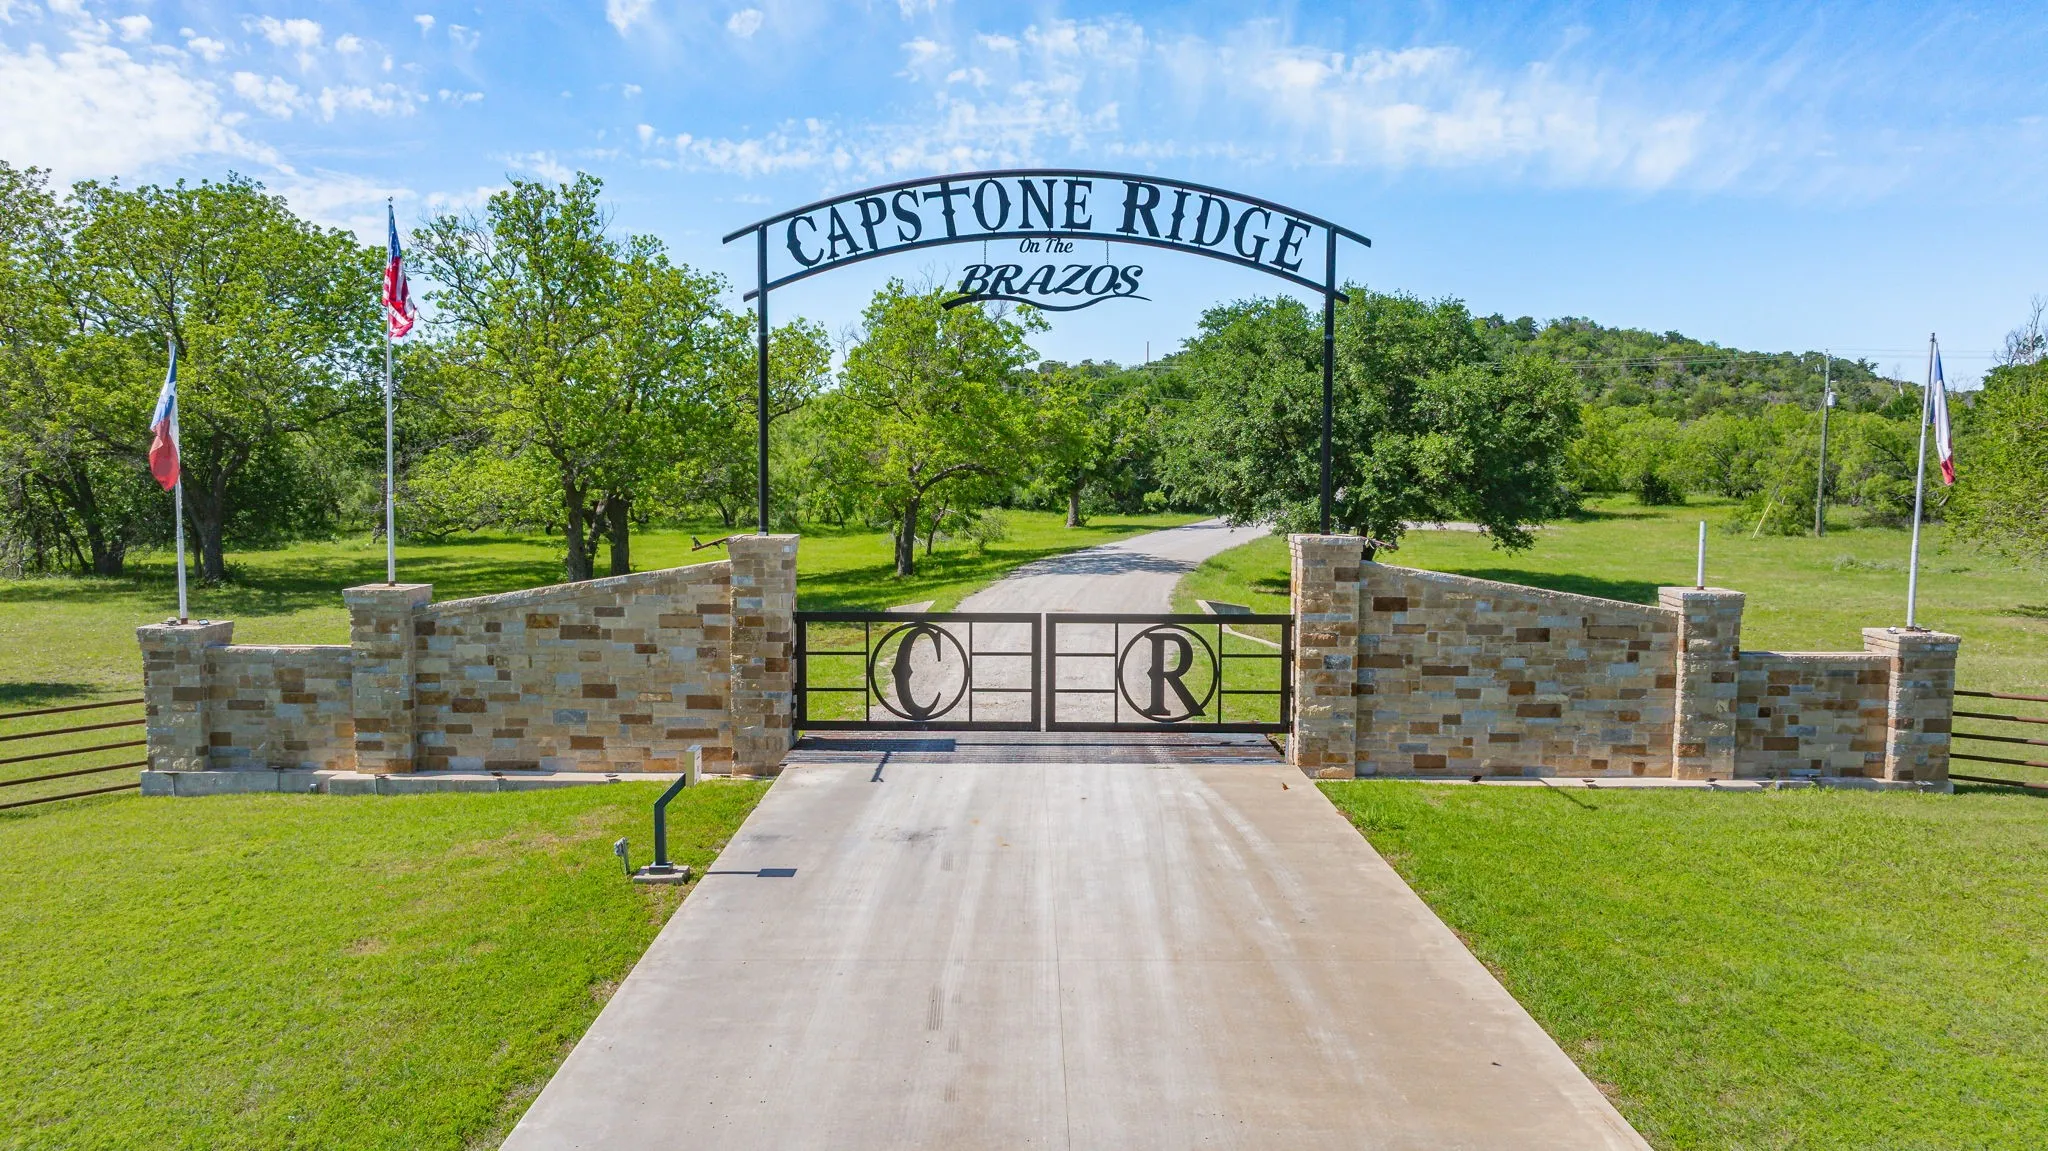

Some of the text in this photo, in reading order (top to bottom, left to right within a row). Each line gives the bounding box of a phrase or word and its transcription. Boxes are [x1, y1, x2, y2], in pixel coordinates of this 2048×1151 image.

[787, 179, 1312, 272] CAPSTONE RIDGE
[1019, 237, 1074, 253] On The
[958, 264, 1143, 295] BRAZOS
[891, 626, 942, 718] C
[1144, 632, 1206, 717] R
